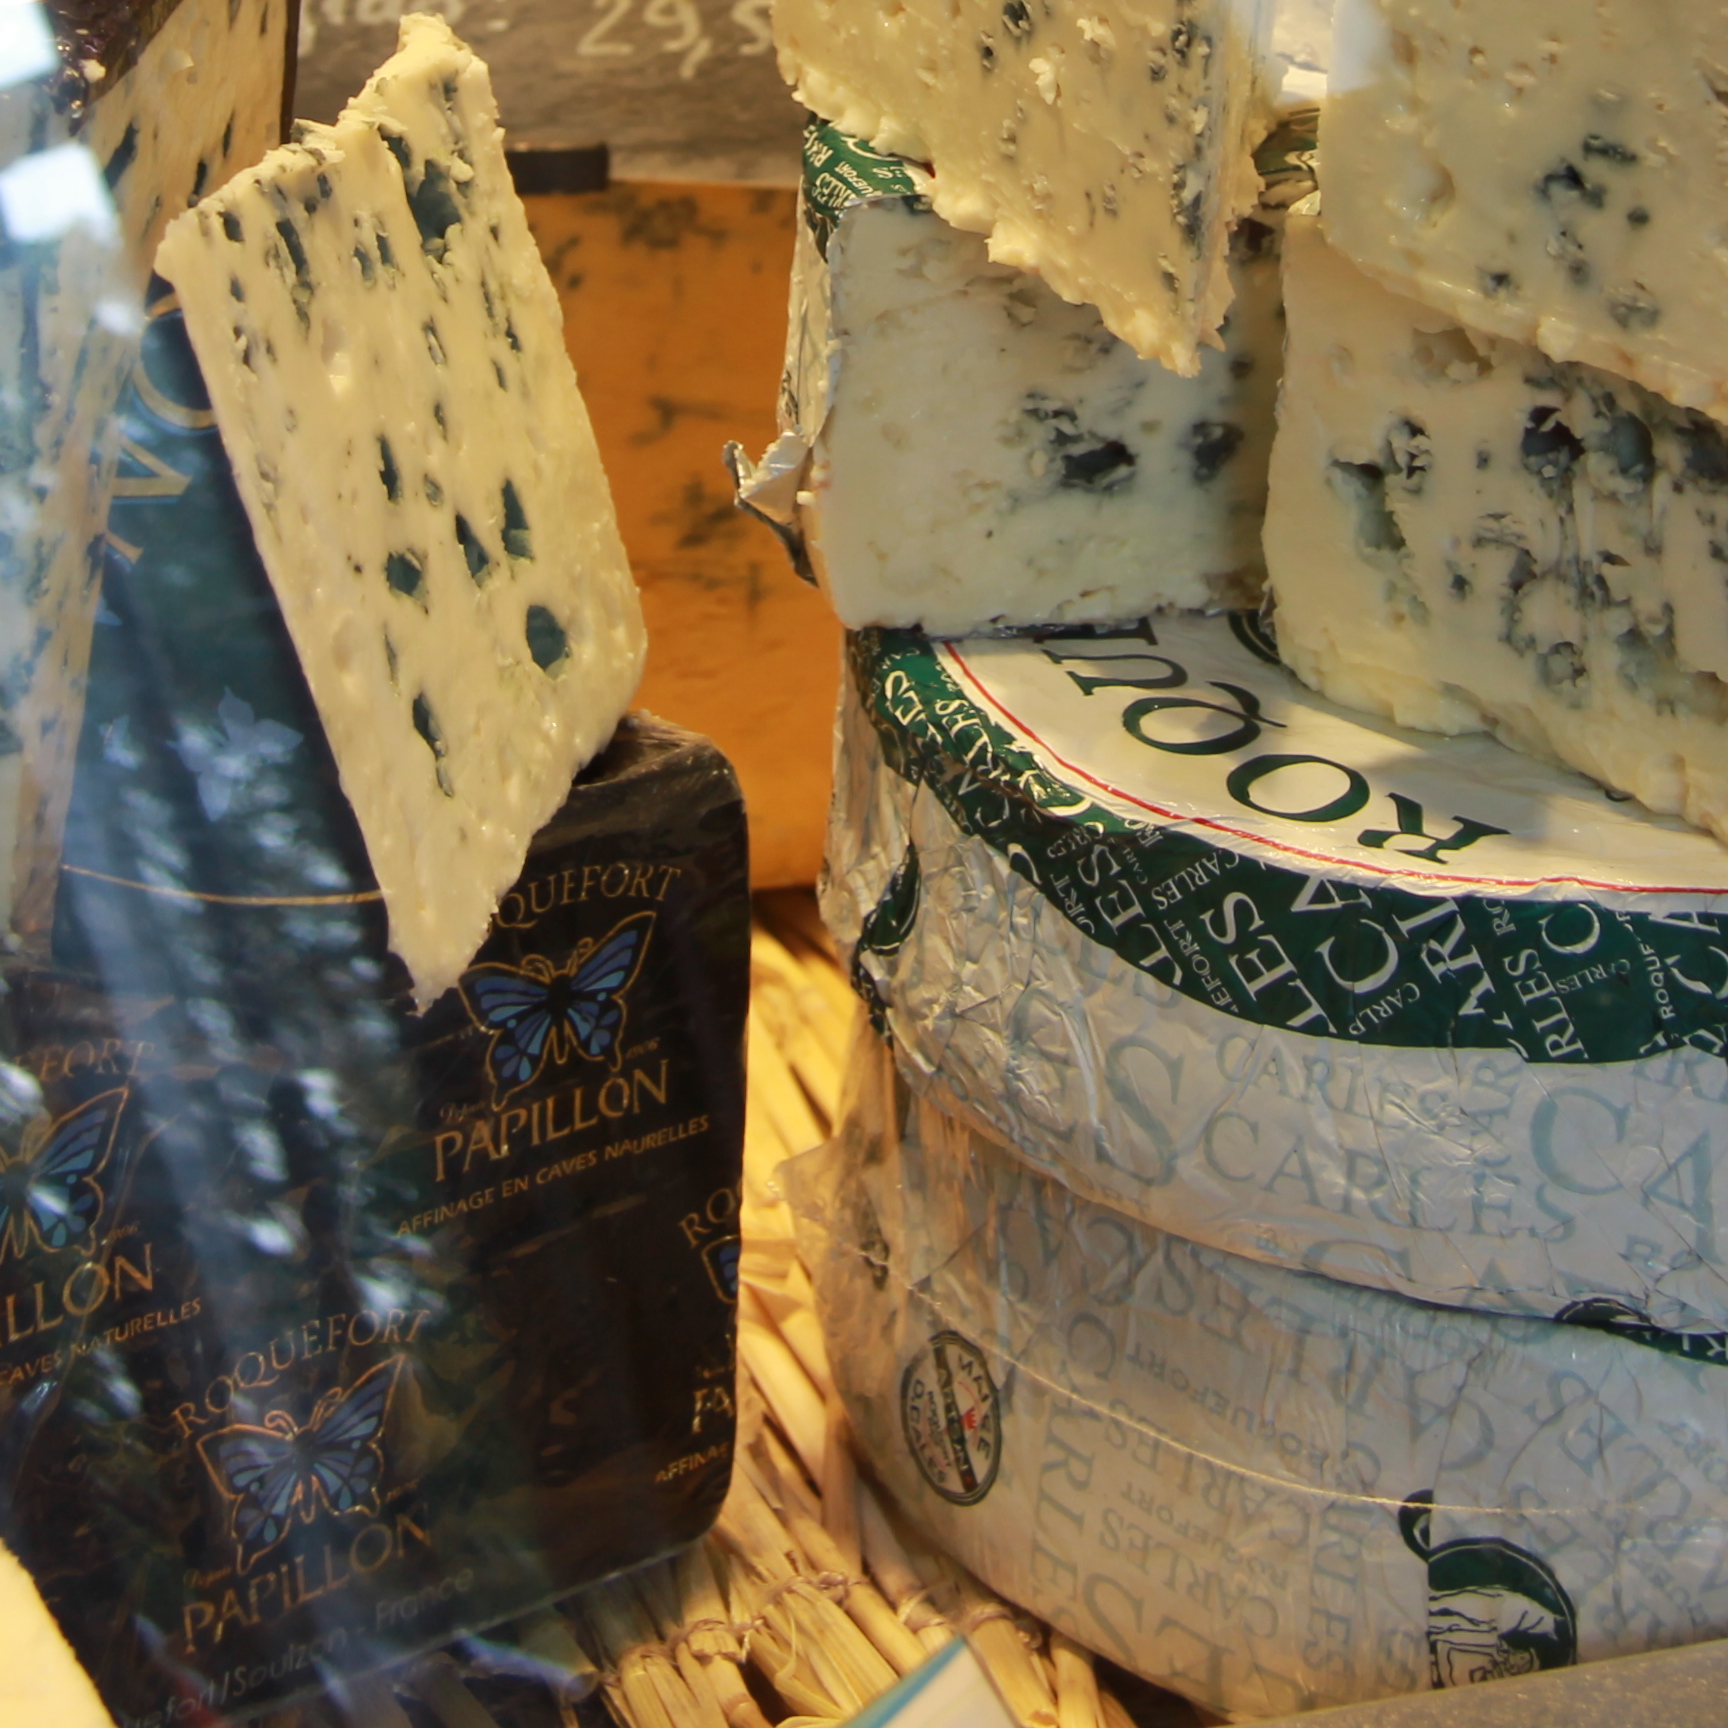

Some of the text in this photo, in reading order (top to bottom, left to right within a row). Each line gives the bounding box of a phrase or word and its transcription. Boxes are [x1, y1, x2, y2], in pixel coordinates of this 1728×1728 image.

[1150, 850, 1241, 912] CARLES
[433, 1058, 670, 1183] PAPILLON
[395, 1187, 495, 1239] AFFINAGE
[501, 1173, 530, 1200] EN
[535, 1151, 599, 1186] CAVES
[171, 1308, 432, 1440] ROQUEFORT
[181, 1502, 431, 1656] PAPILLON
